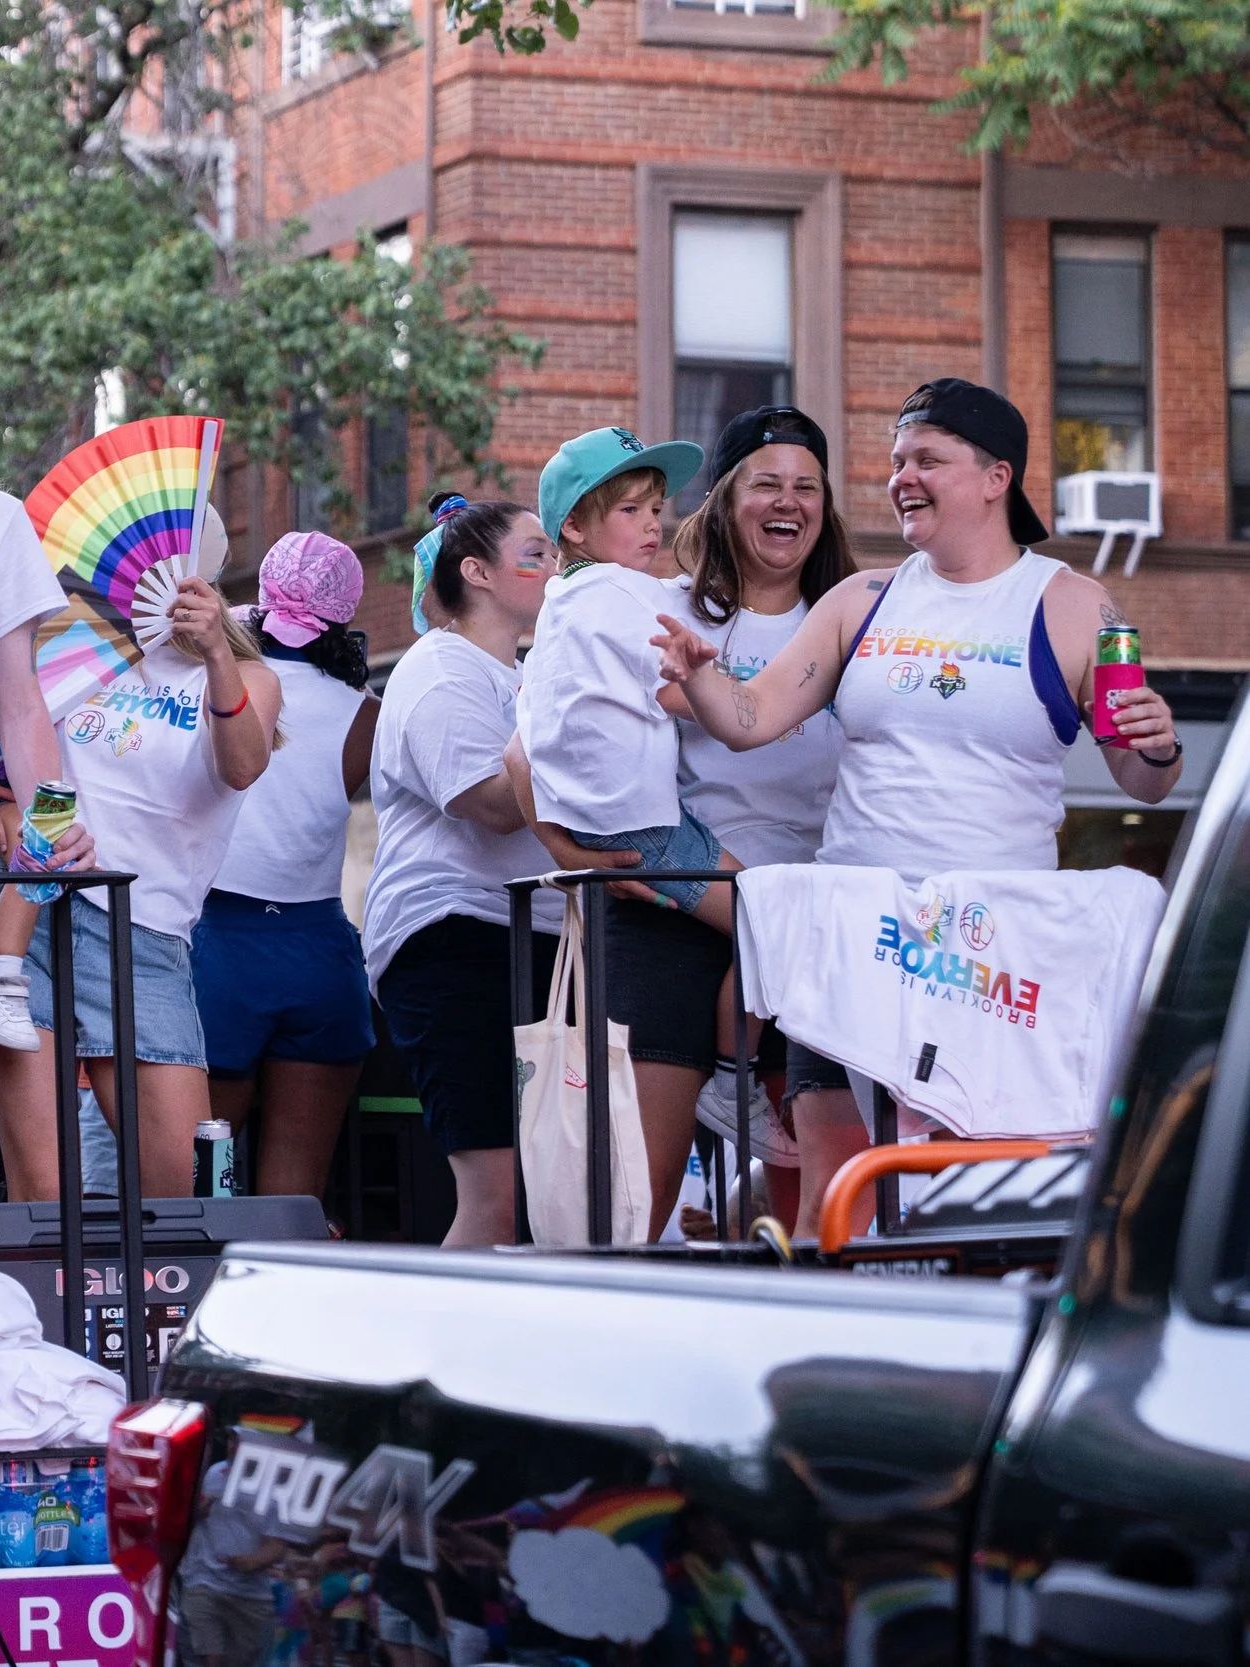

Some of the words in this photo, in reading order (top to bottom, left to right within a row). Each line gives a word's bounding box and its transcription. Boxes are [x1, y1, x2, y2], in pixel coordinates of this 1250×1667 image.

[873, 627, 954, 640] ROOKLYN
[992, 635, 1027, 645] FOR
[856, 637, 1024, 667] EVERYONE
[103, 684, 151, 696] KLYN
[156, 686, 171, 697] IS
[85, 691, 199, 731] ERYONE
[874, 947, 901, 966] OR
[877, 915, 1041, 1014] EVERYOE
[924, 983, 1037, 1029] BROOKLYN
